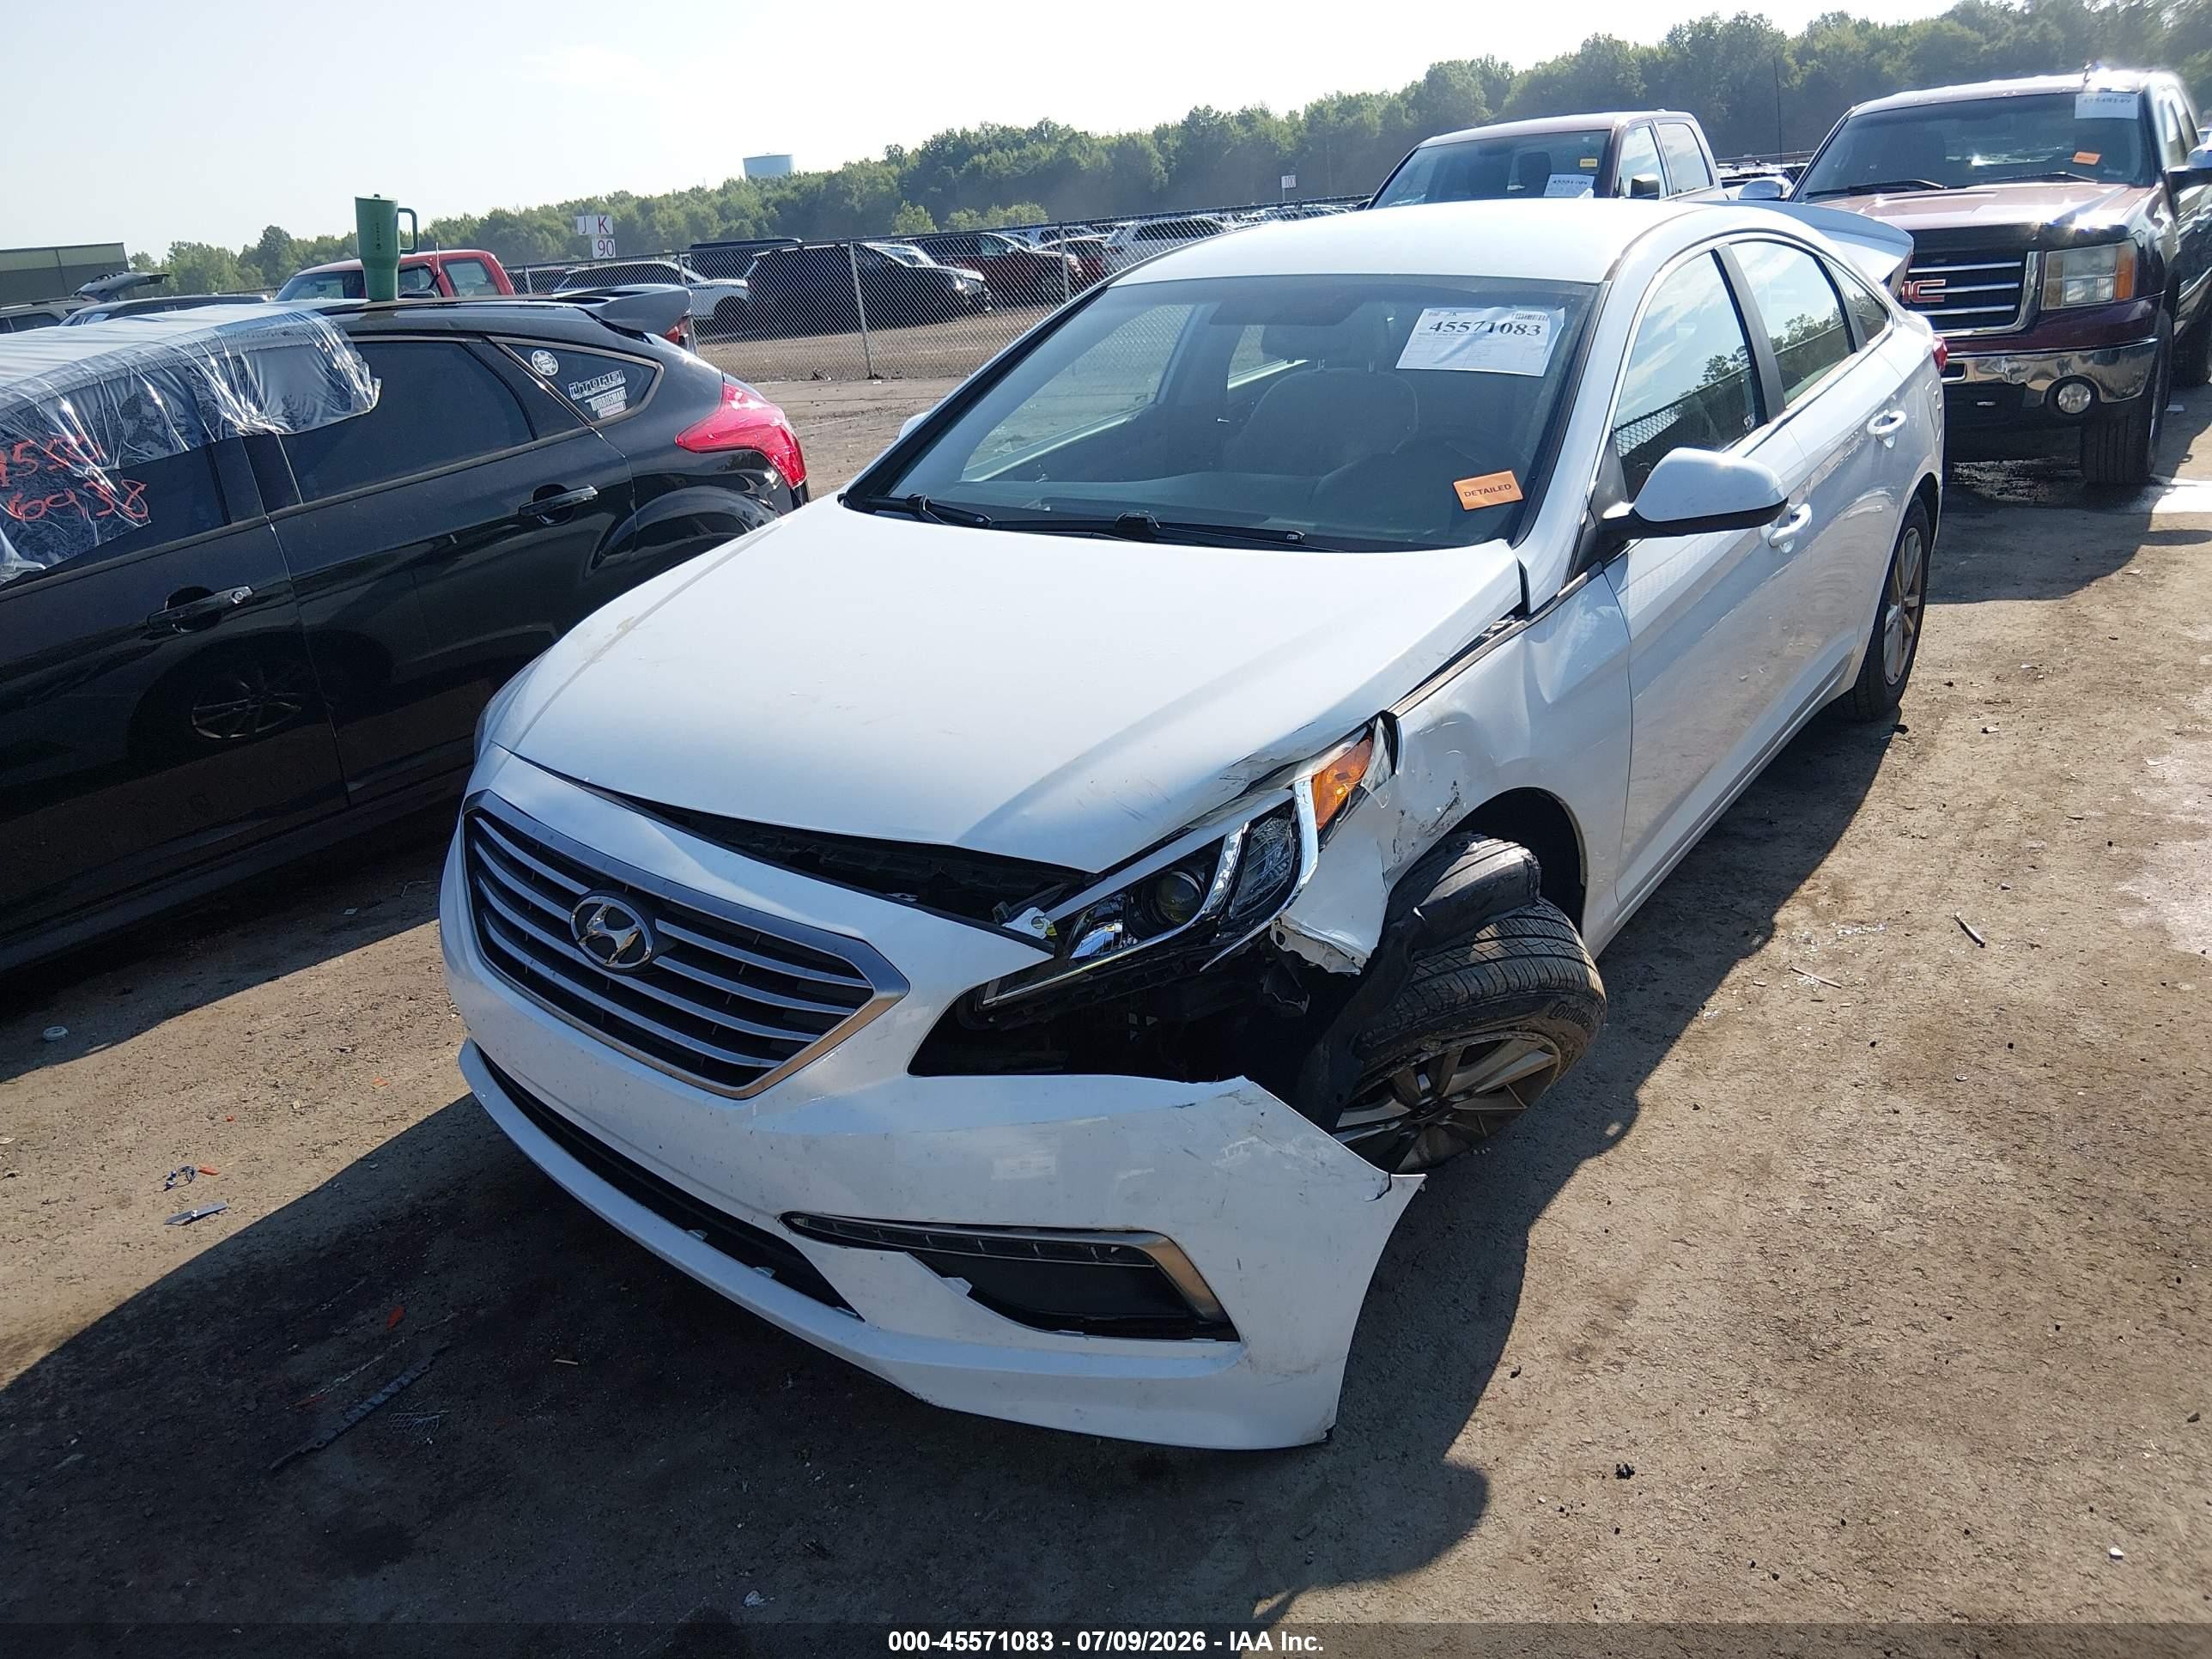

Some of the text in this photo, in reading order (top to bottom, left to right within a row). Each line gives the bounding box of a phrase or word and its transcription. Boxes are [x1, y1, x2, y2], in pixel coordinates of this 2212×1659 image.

[582, 216, 610, 234] J K
[597, 240, 615, 257] 90
[1429, 320, 1542, 337] 45571083
[1463, 483, 1512, 498] DETAILED
